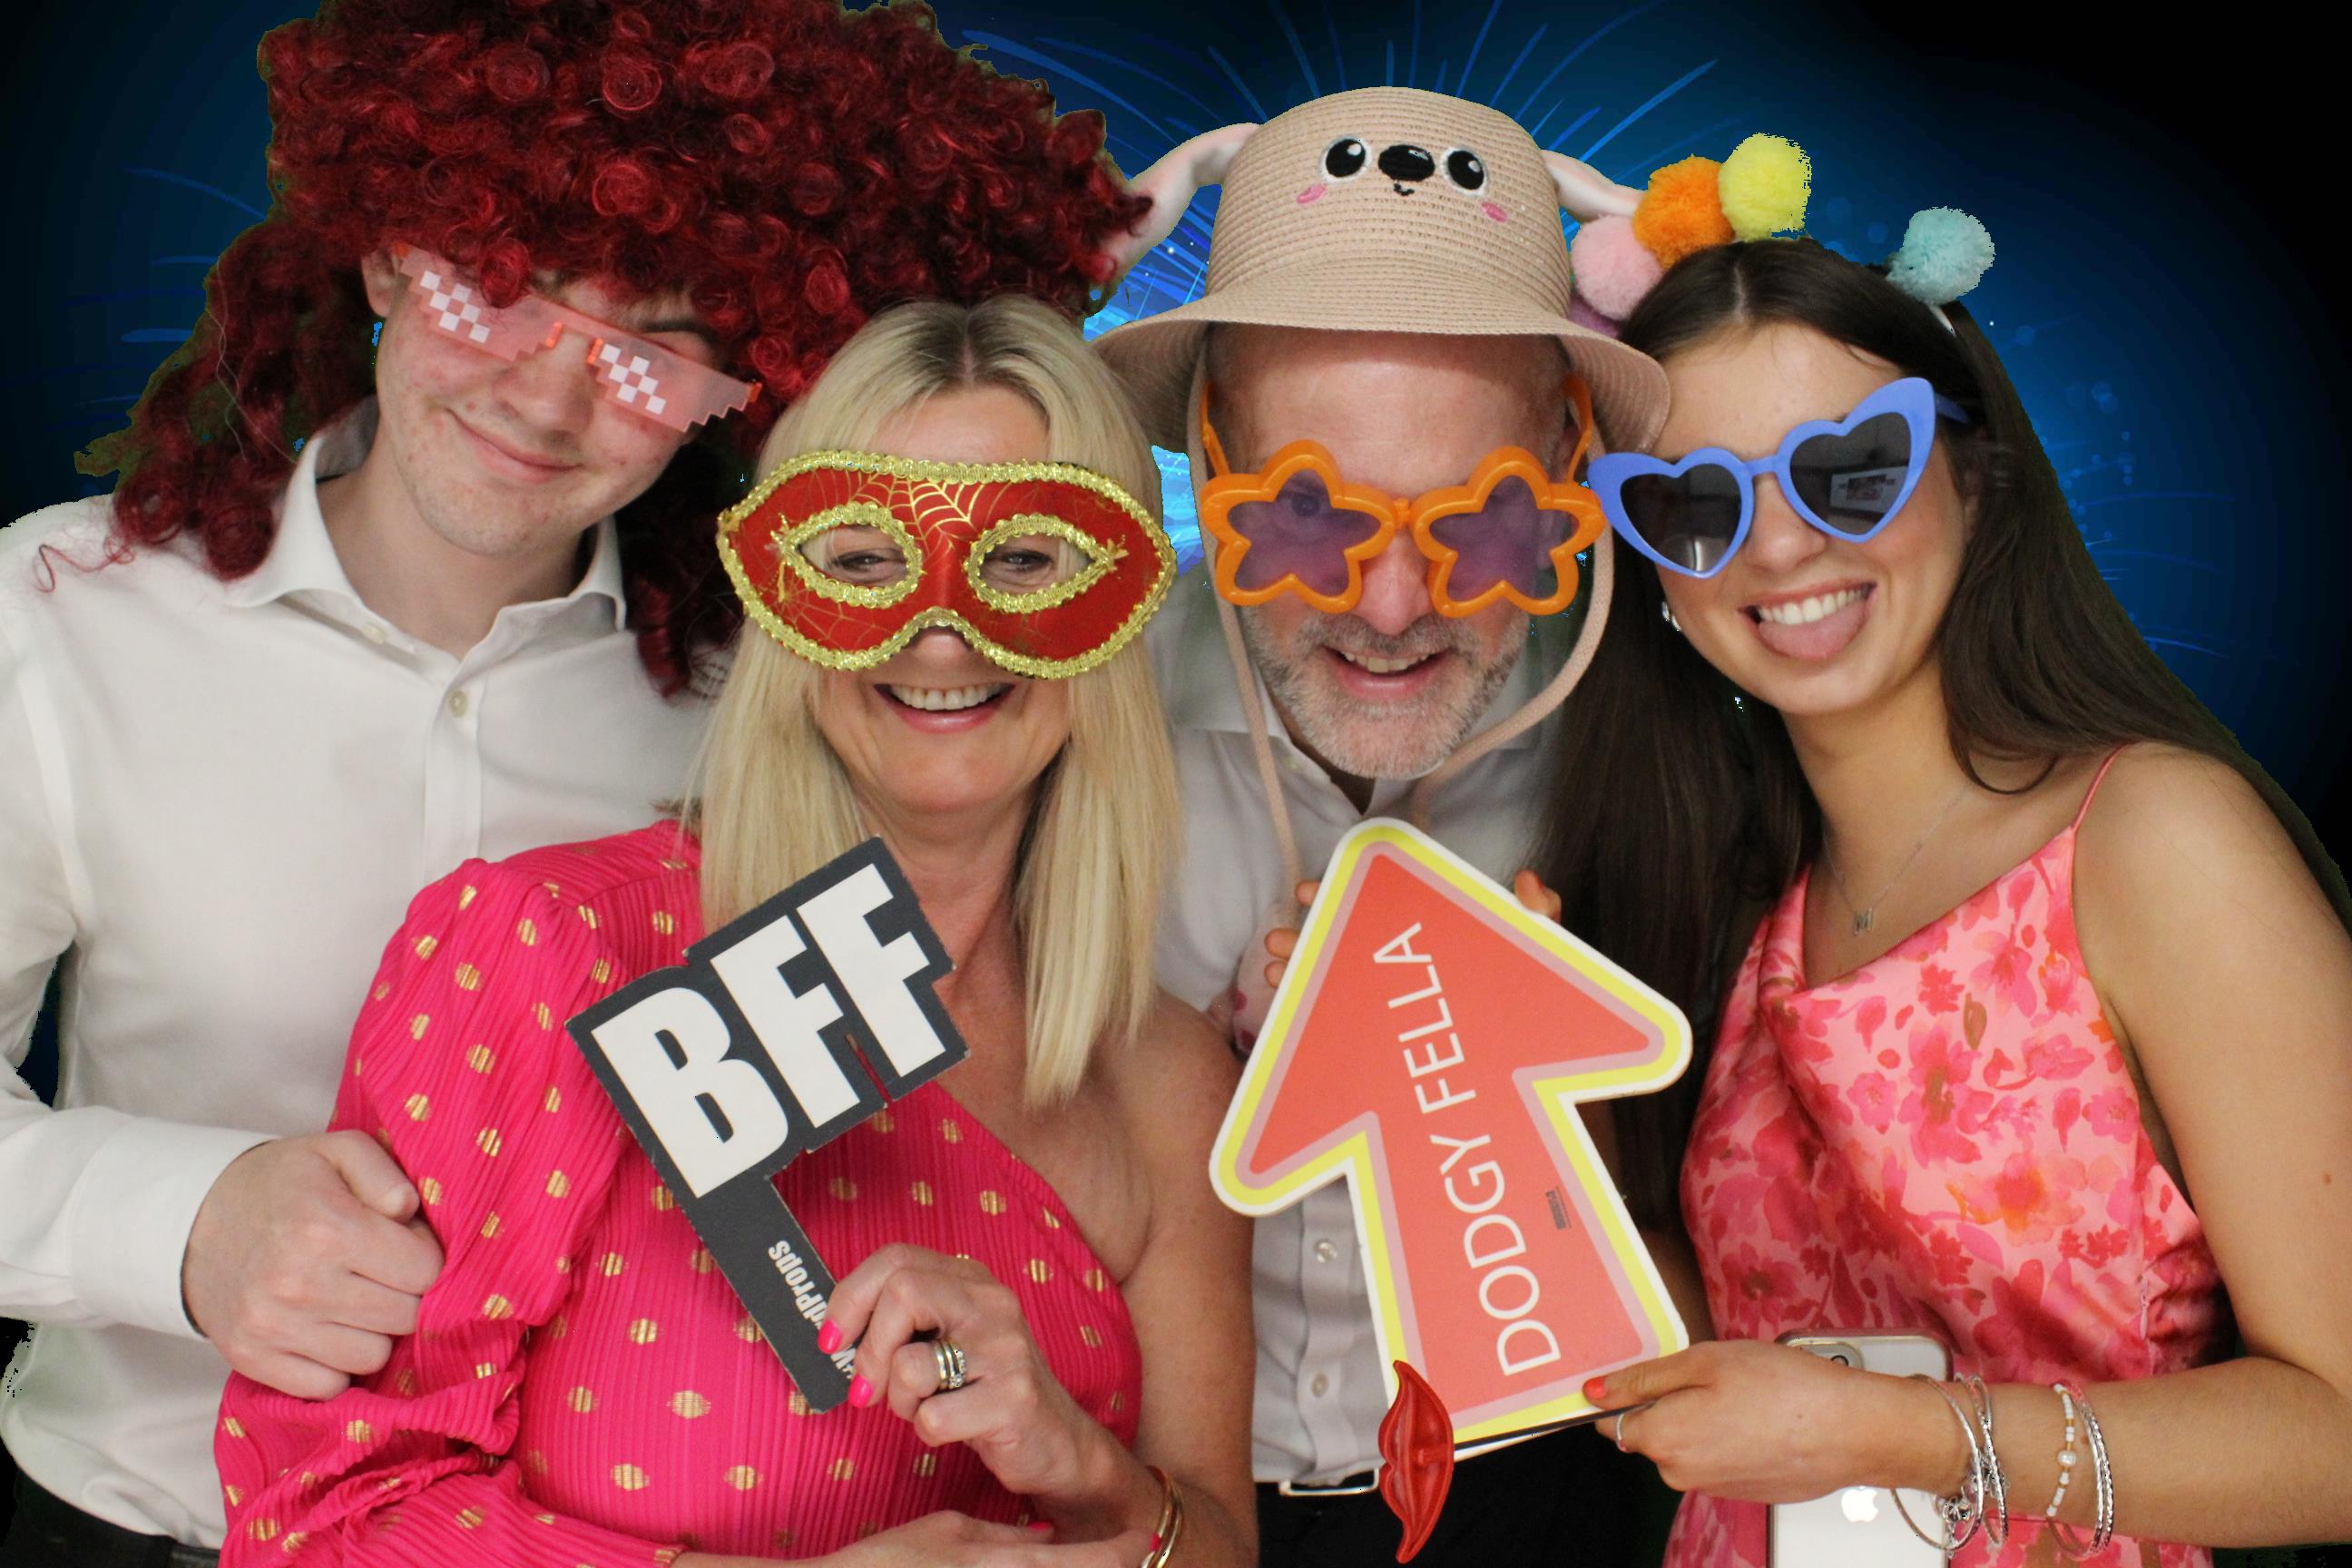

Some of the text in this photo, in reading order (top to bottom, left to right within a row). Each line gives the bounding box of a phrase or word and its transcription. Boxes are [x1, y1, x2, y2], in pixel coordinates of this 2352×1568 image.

[593, 864, 946, 1198] BFF
[1373, 922, 1561, 1376] DODGY FELLA
